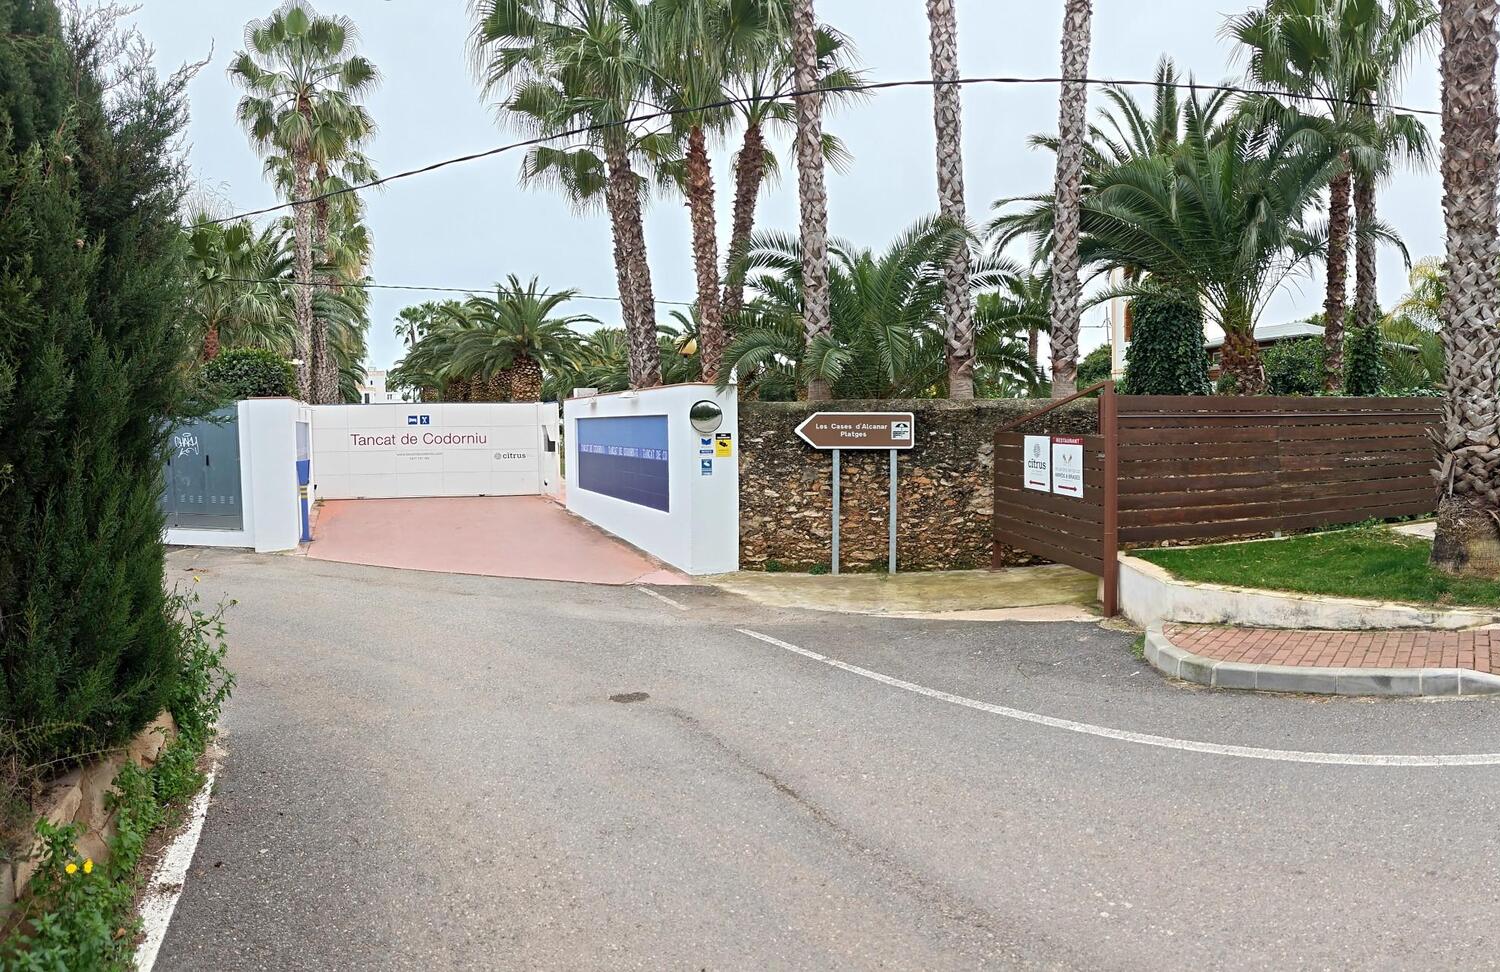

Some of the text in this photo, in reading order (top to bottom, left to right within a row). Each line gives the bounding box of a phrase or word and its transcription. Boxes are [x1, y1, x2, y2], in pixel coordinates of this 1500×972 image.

[350, 432, 487, 446] Tancat de Codorniu
[1028, 458, 1047, 470] citrus
